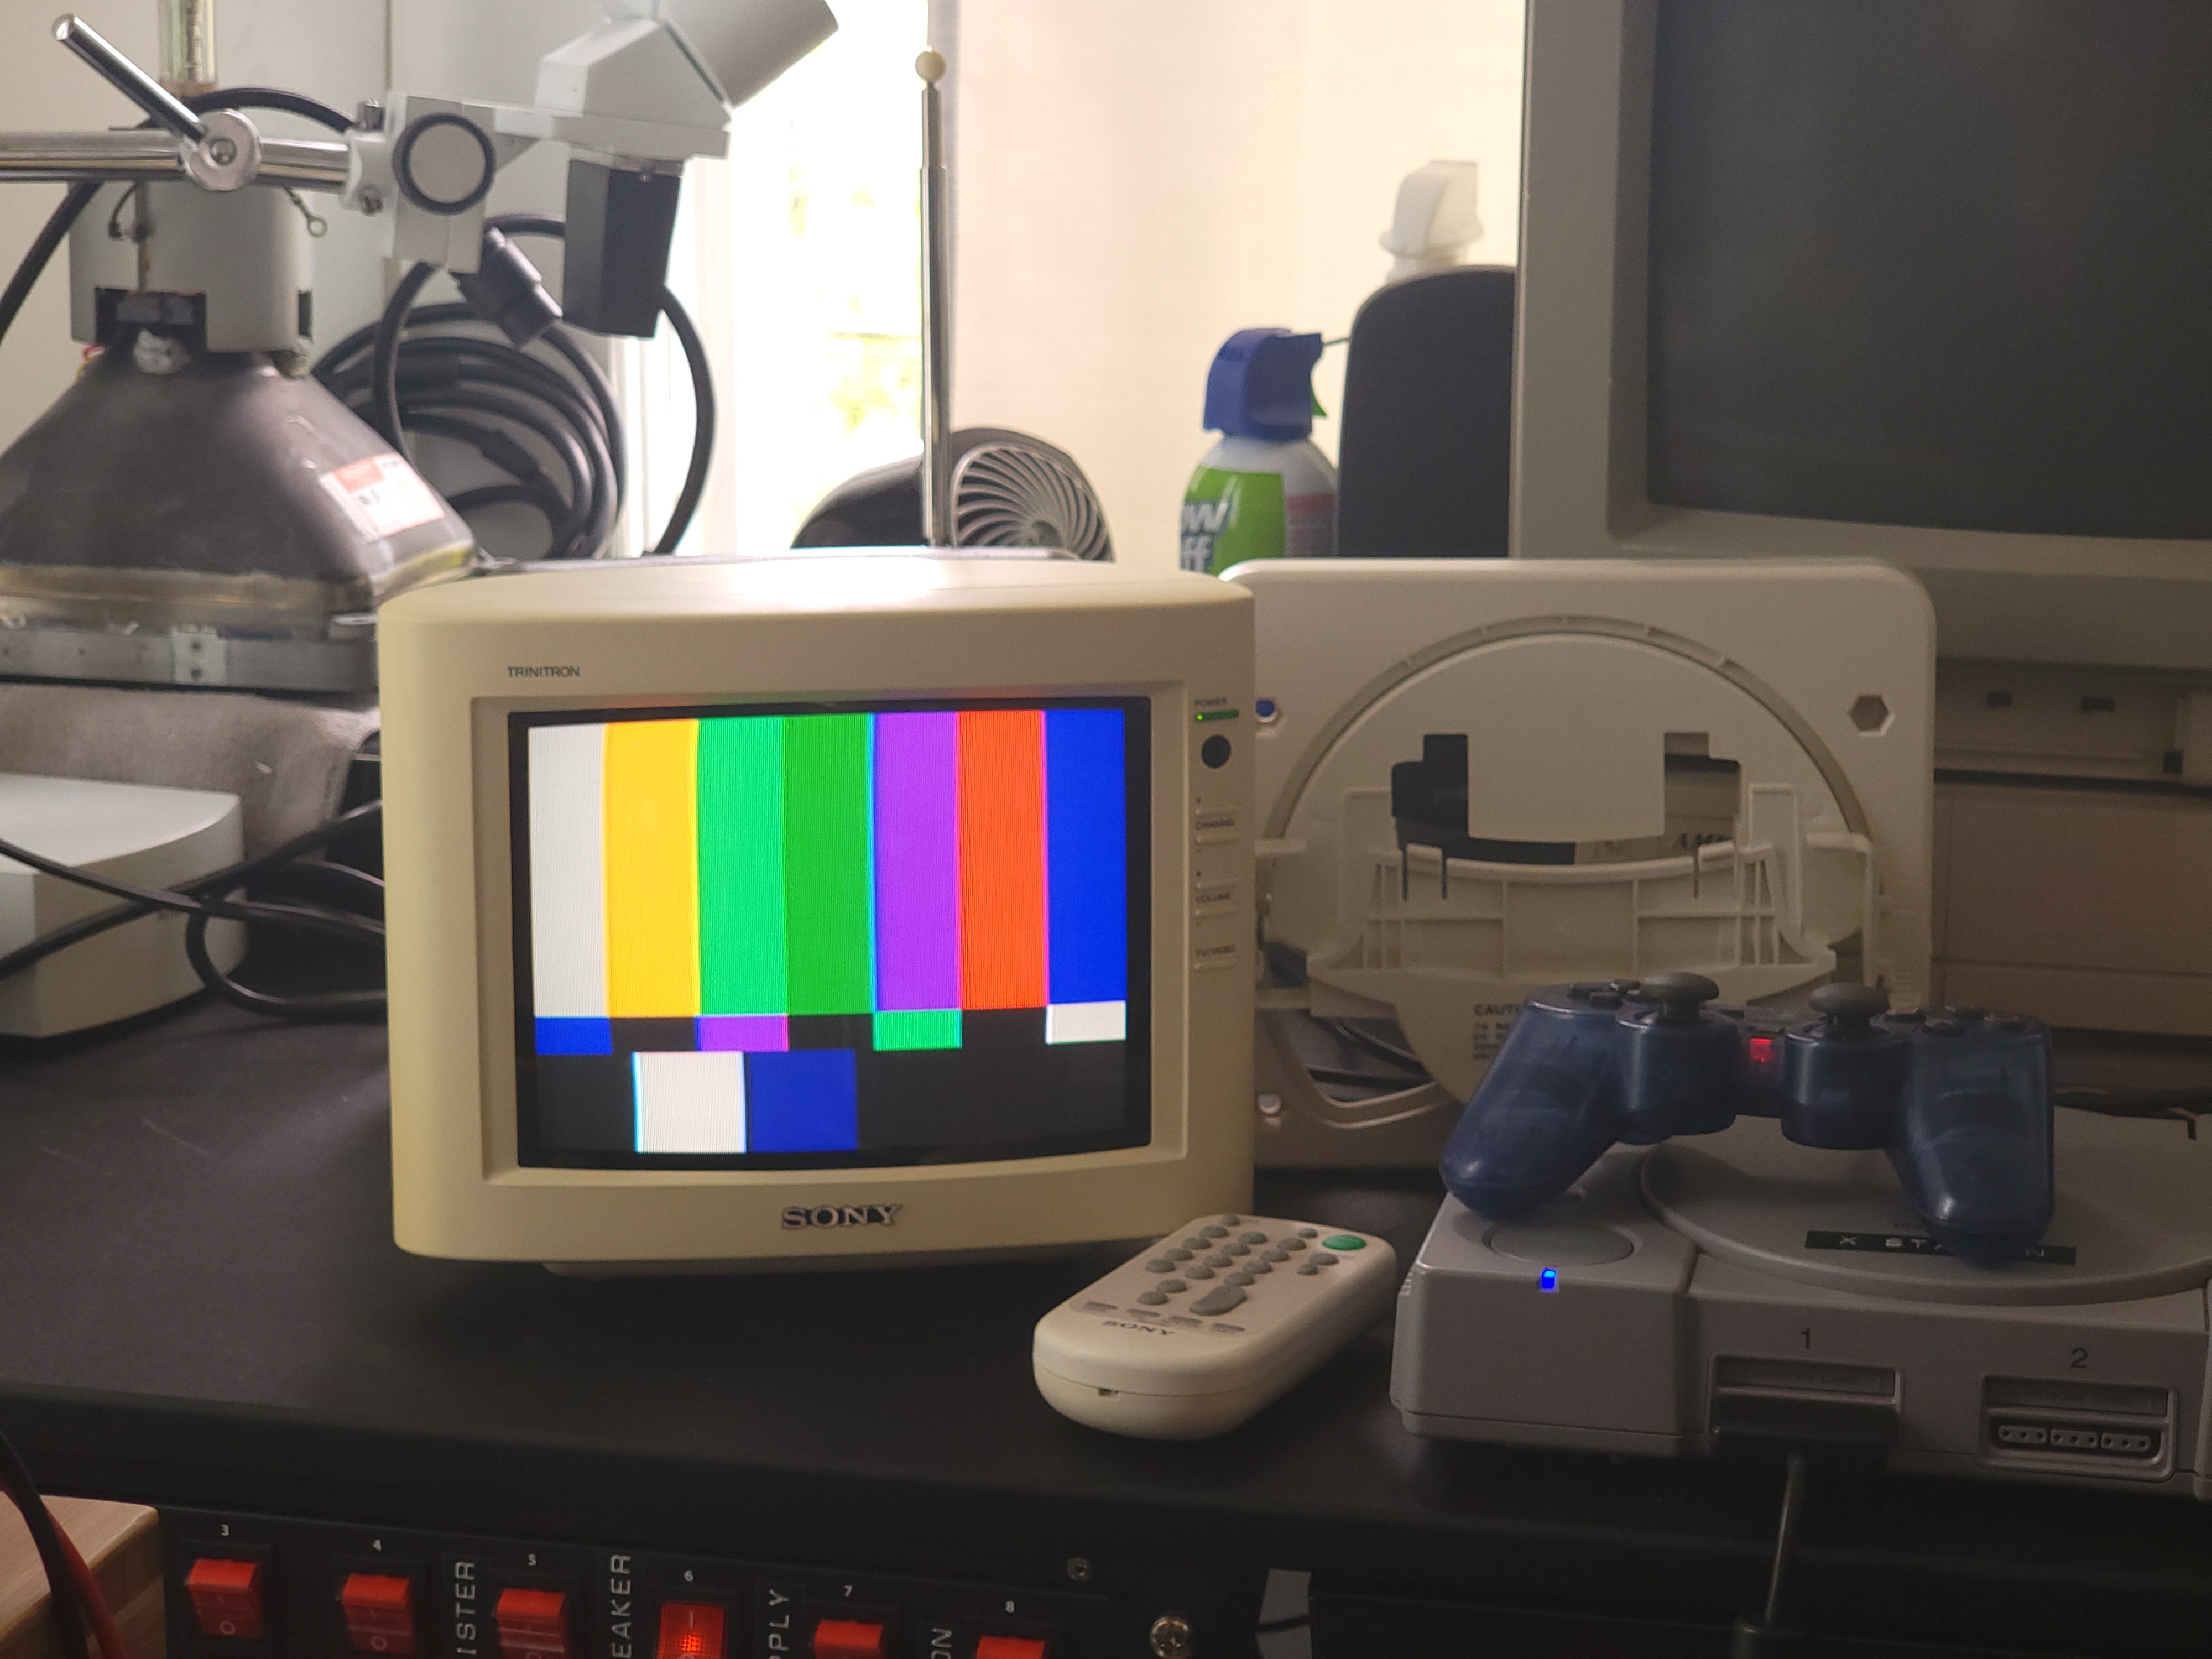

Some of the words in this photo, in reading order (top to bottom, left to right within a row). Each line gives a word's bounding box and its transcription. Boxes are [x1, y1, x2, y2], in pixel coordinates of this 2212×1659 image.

[507, 665, 580, 678] TRINITRON
[780, 1204, 903, 1230] SONY
[1839, 1235, 1858, 1245] X
[1801, 1328, 1811, 1349] 1
[2070, 1347, 2088, 1369] 2
[220, 1524, 229, 1536] 3
[372, 1539, 381, 1552] 4
[526, 1553, 536, 1566] 5
[683, 1569, 694, 1582] 6
[842, 1584, 852, 1598] 7
[609, 1554, 632, 1658] EAKER
[1004, 1600, 1015, 1613] 8
[768, 1588, 790, 1659] PLY
